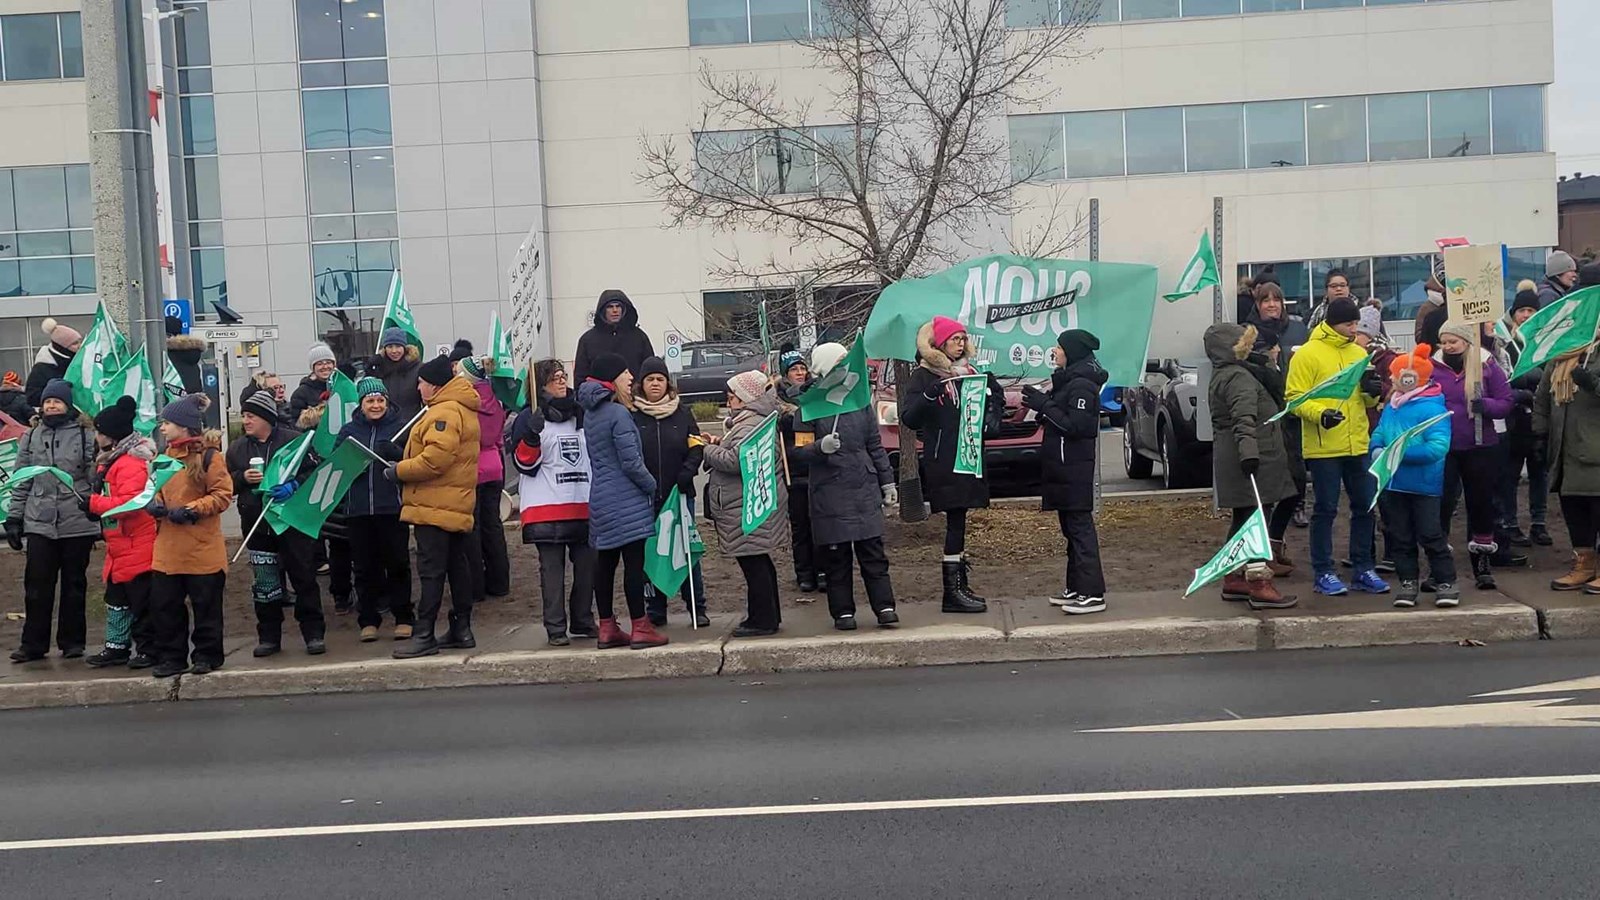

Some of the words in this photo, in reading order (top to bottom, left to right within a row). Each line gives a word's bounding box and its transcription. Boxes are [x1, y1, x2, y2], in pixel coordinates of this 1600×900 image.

[958, 262, 1092, 336] NOUS
[990, 305, 1020, 321] D'UNE
[1021, 298, 1050, 315] SEULE
[1052, 292, 1075, 308] VOIX
[170, 306, 177, 316] P
[1462, 301, 1490, 316] NOUS
[206, 375, 216, 386] P
